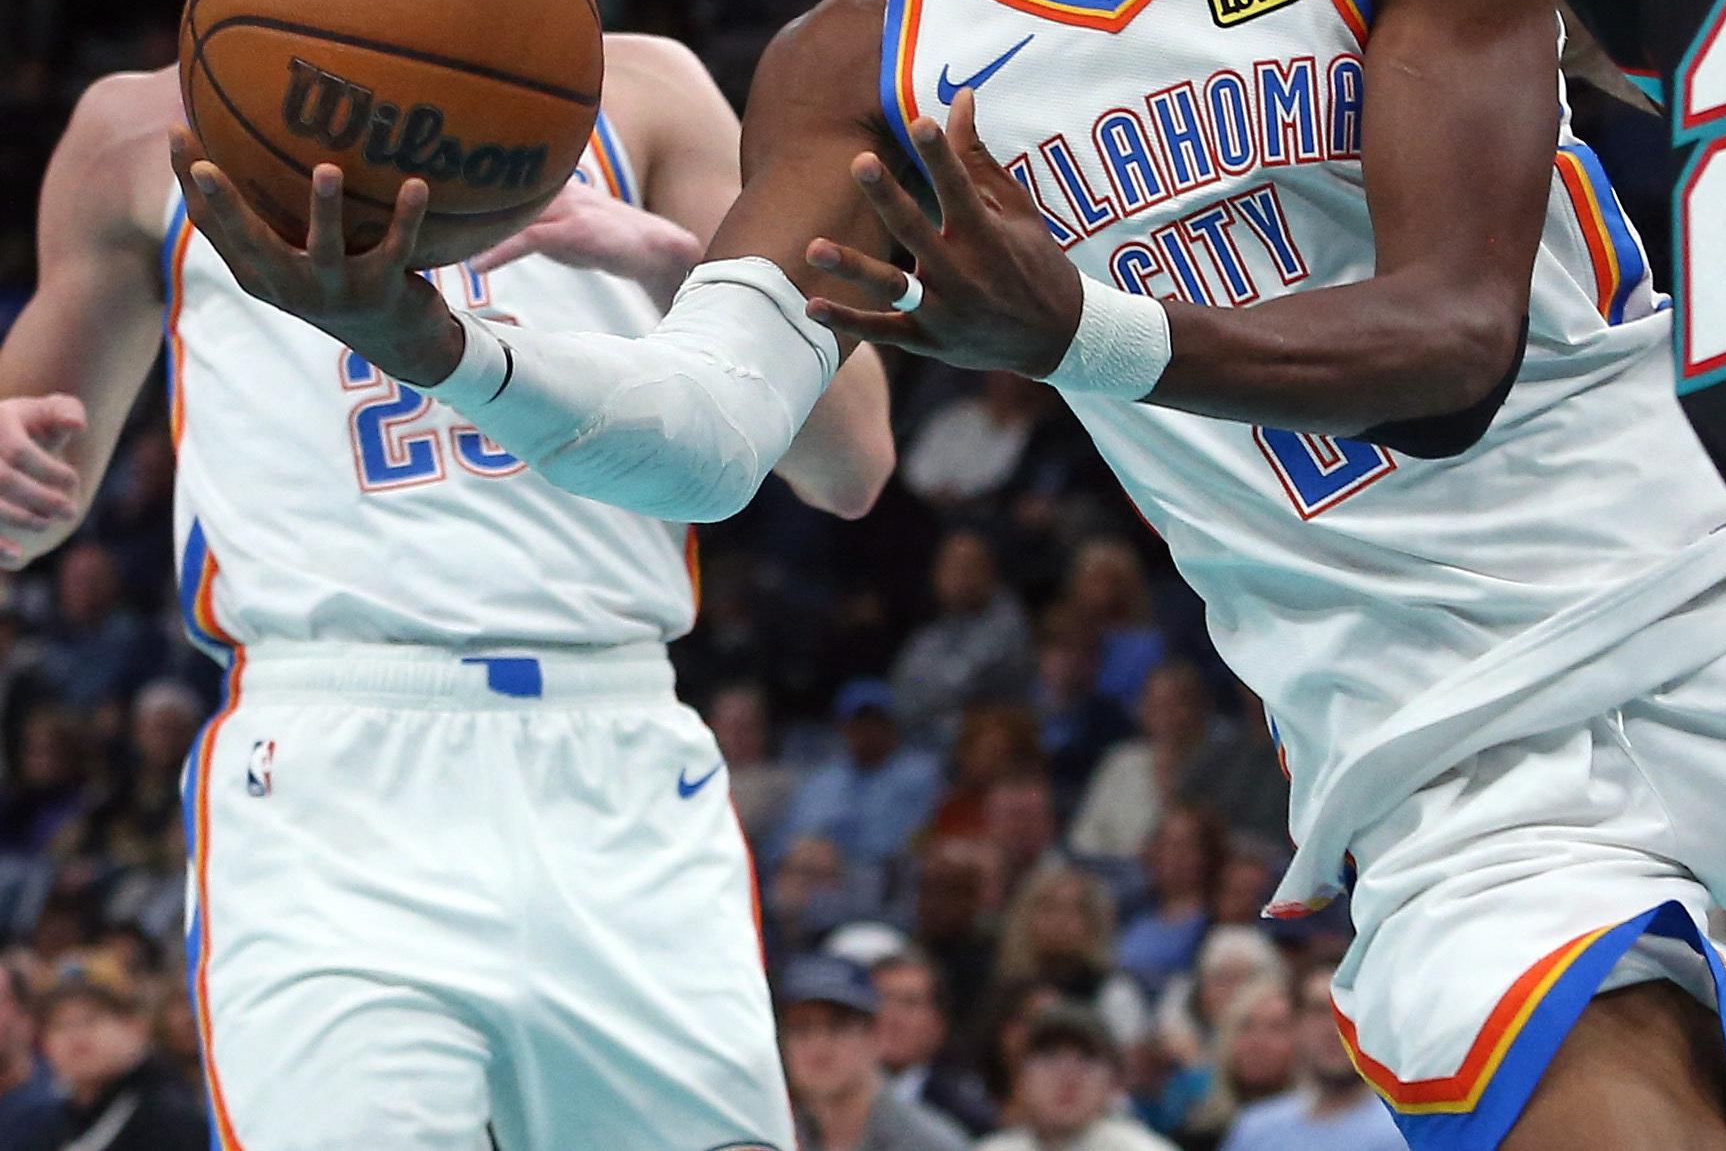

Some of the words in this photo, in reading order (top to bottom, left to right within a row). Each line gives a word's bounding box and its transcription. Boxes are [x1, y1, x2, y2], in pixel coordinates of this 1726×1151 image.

[281, 56, 549, 187] Wilson
[1002, 52, 1364, 252] LAHOMA
[1108, 181, 1310, 308] CITY
